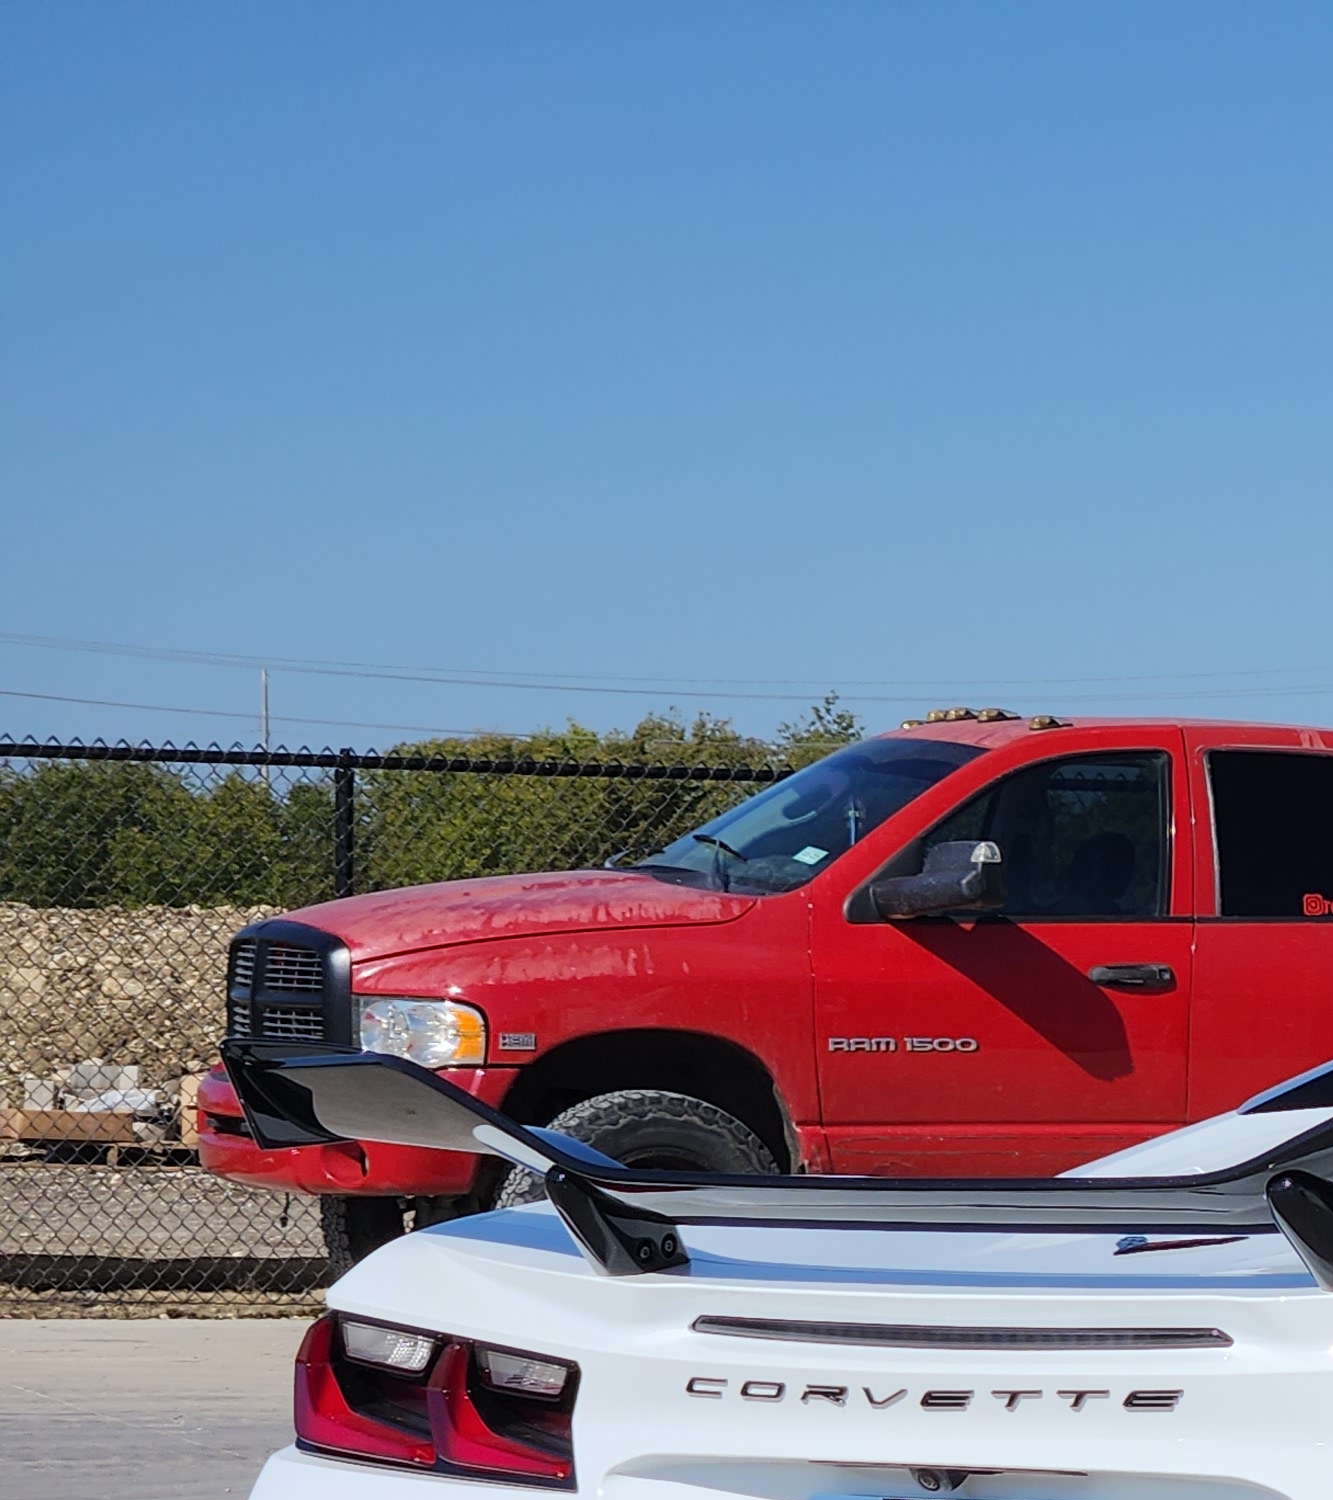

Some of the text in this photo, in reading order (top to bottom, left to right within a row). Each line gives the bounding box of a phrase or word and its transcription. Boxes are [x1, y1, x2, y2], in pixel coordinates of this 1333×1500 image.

[828, 1037, 979, 1052] RAM 1500
[685, 1376, 1185, 1413] CORVETTE
